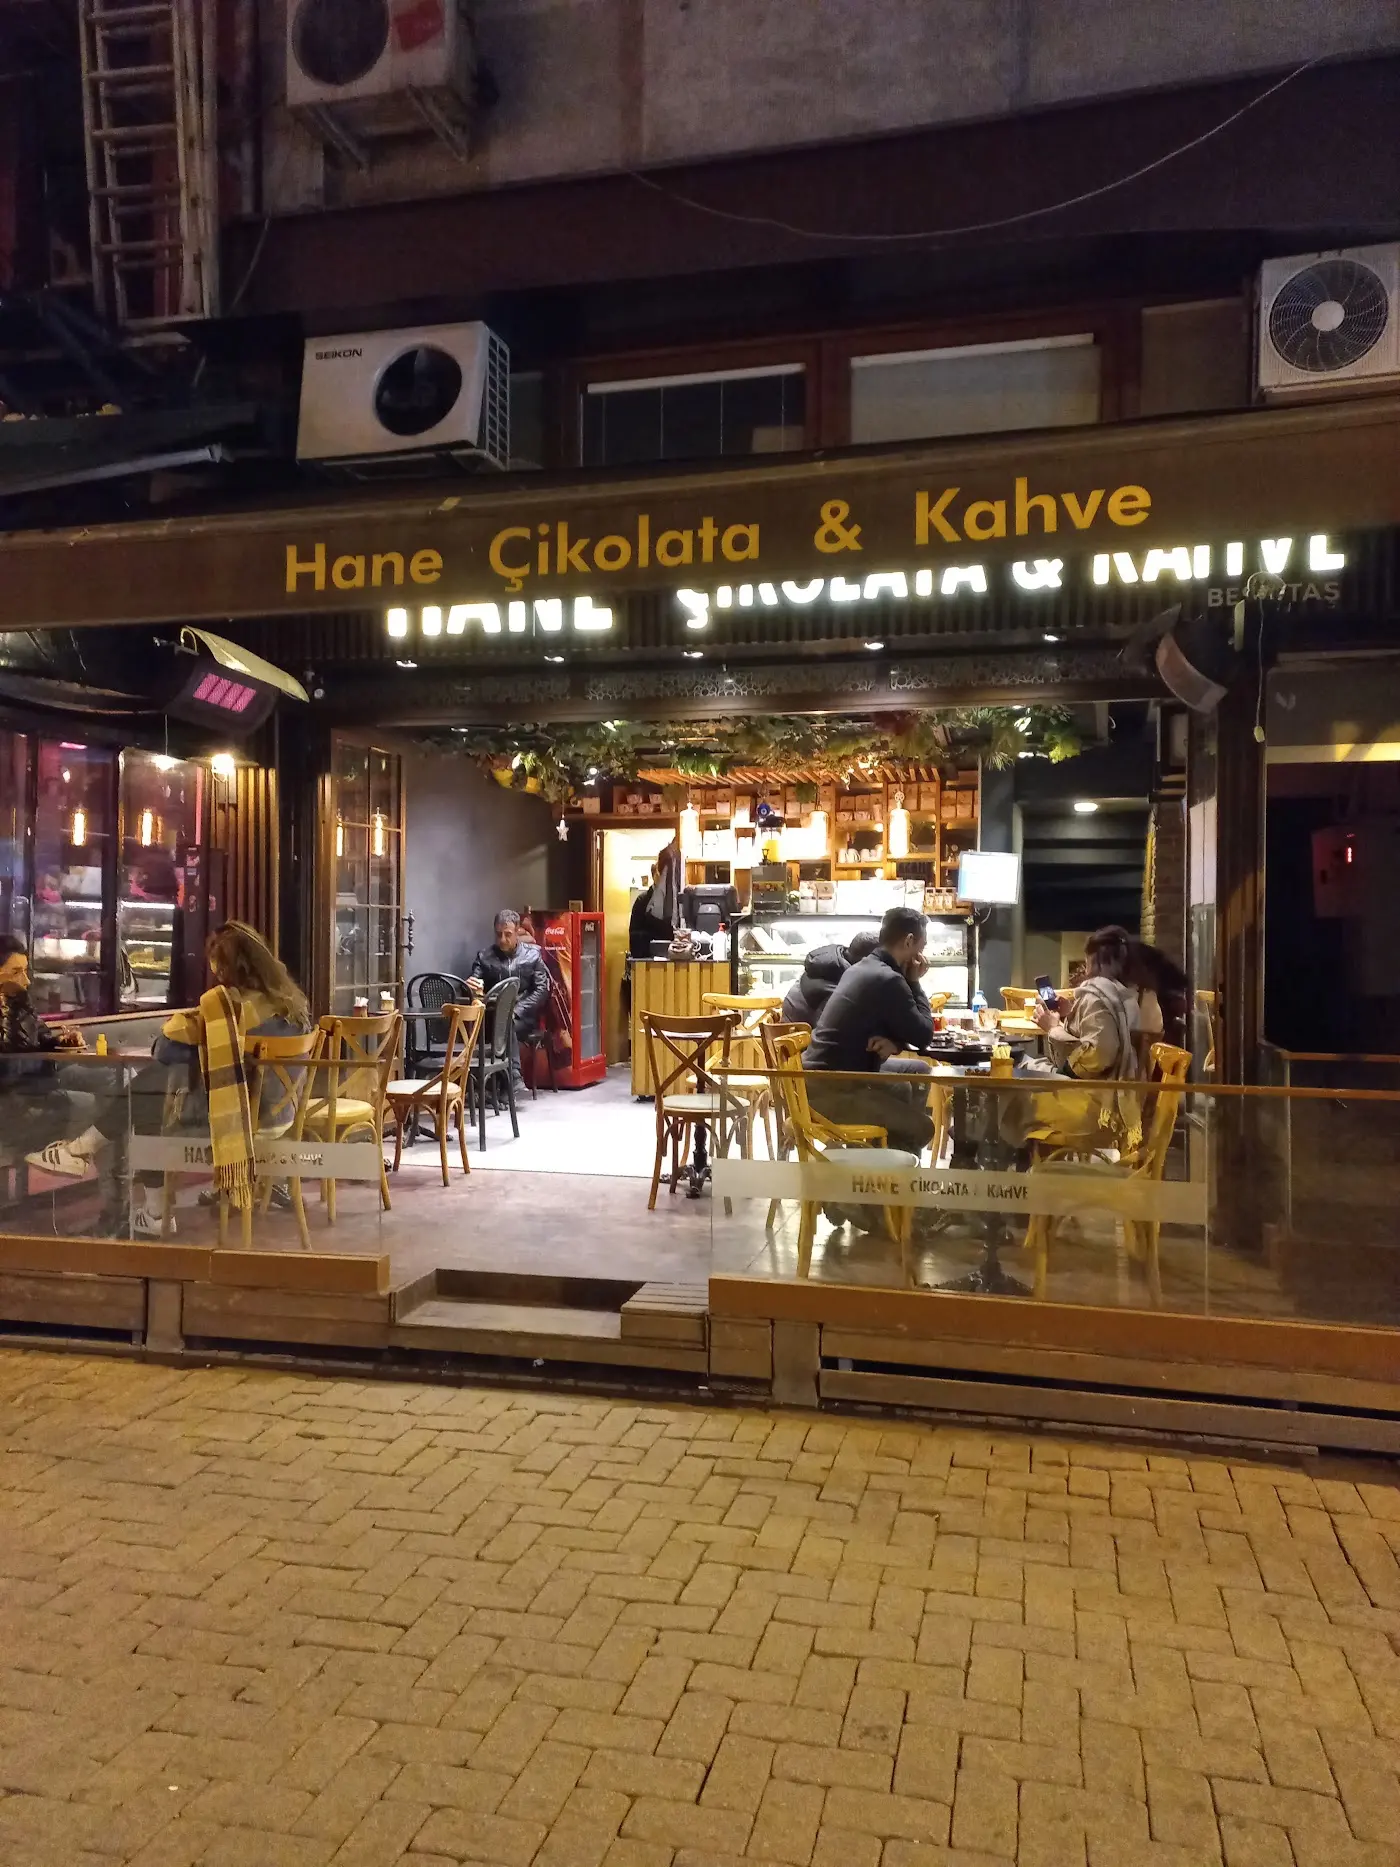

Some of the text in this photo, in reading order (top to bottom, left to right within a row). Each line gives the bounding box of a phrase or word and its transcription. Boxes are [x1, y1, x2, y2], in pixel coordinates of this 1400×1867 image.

[315, 348, 363, 361] SEIKON
[285, 476, 1153, 593] Hane Çikolata & Kahve
[1207, 581, 1340, 609] BETAŞ
[184, 1145, 214, 1165] HA
[852, 1174, 900, 1195] HANE
